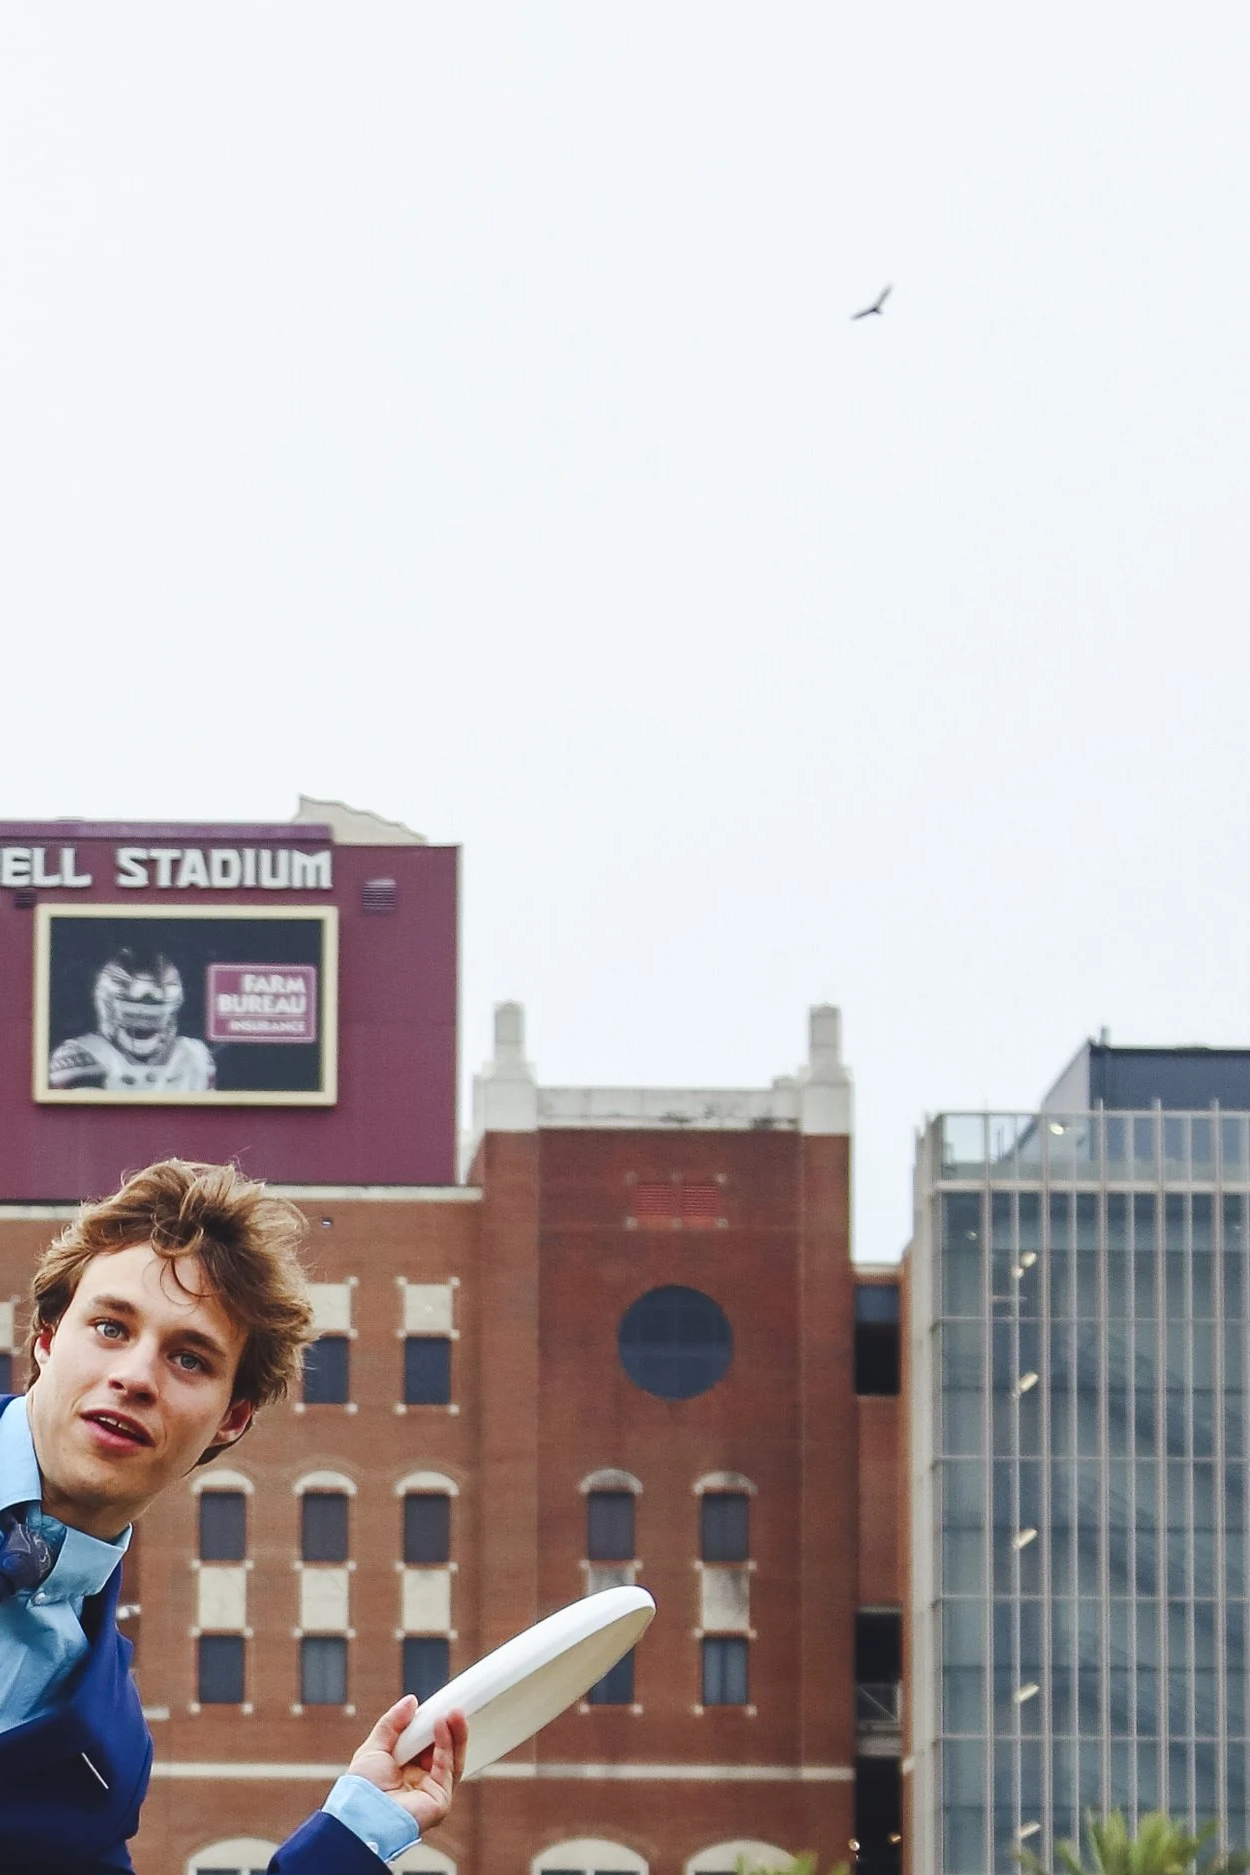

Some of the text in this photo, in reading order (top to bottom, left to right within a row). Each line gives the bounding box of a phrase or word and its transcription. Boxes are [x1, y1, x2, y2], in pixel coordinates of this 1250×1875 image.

[116, 847, 334, 890] STADIUM
[243, 974, 306, 993] FARM
[217, 993, 306, 1013] BUREAU
